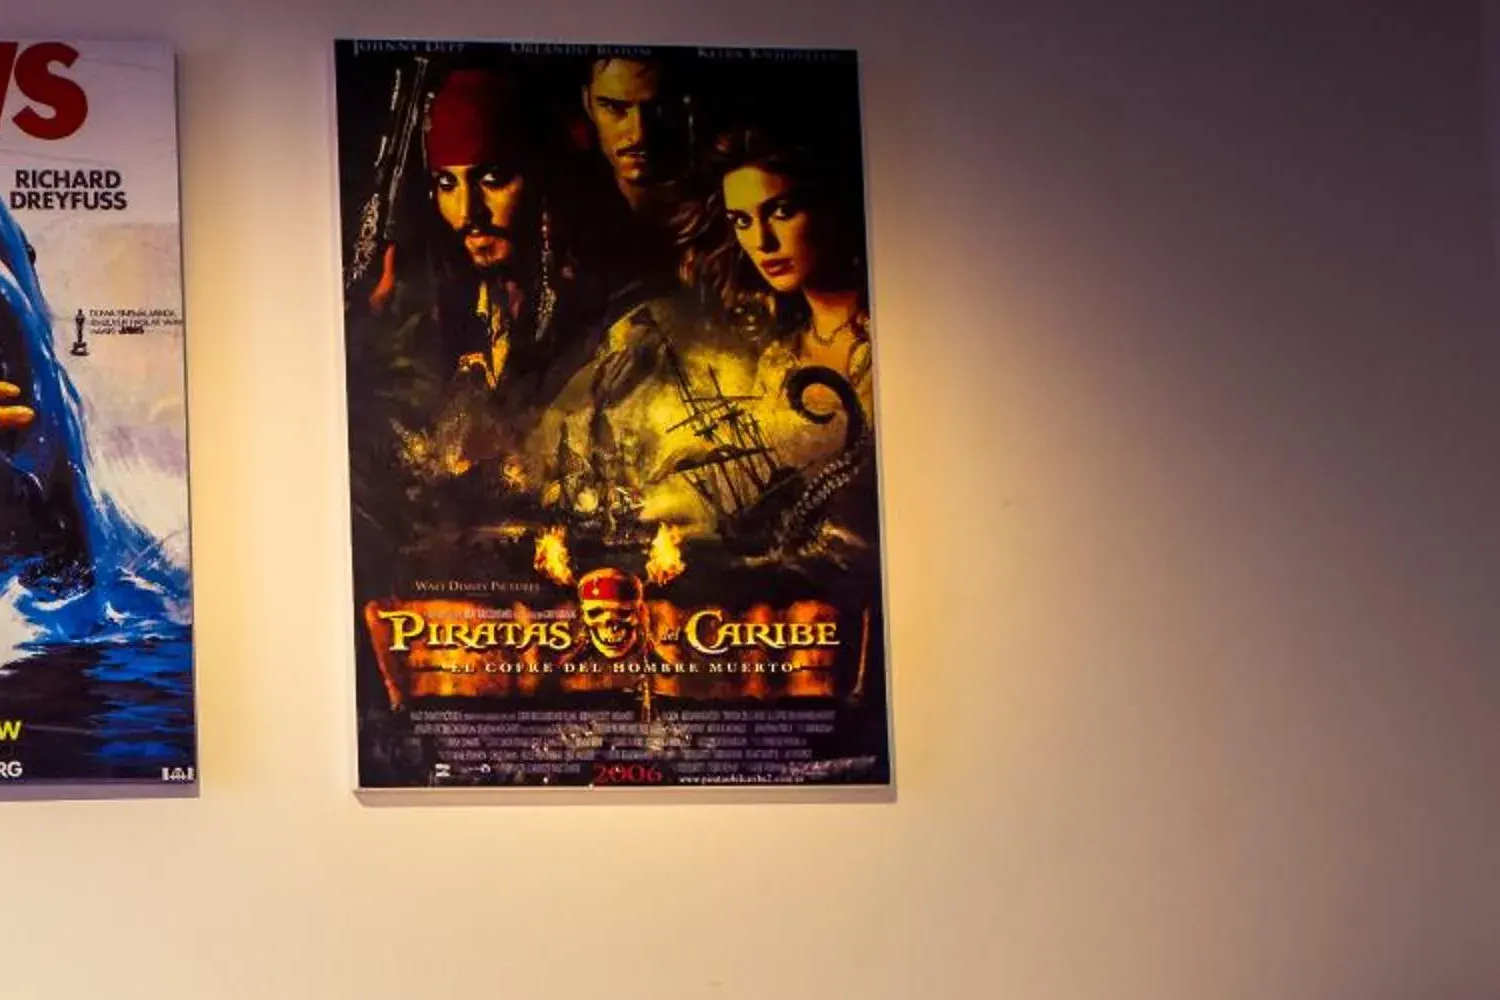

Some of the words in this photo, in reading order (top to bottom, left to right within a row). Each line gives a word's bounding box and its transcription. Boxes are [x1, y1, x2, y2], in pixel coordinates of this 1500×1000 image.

[14, 169, 122, 189] RICHARD
[10, 190, 128, 211] DREYFUSS
[378, 609, 572, 651] PIRATAS
[685, 609, 842, 655] CARIBE
[485, 662, 553, 674] COFRE
[563, 662, 602, 674] DEL
[613, 661, 700, 673] HOMBRE
[709, 661, 794, 673] MUERTO
[593, 762, 663, 783] 2006
